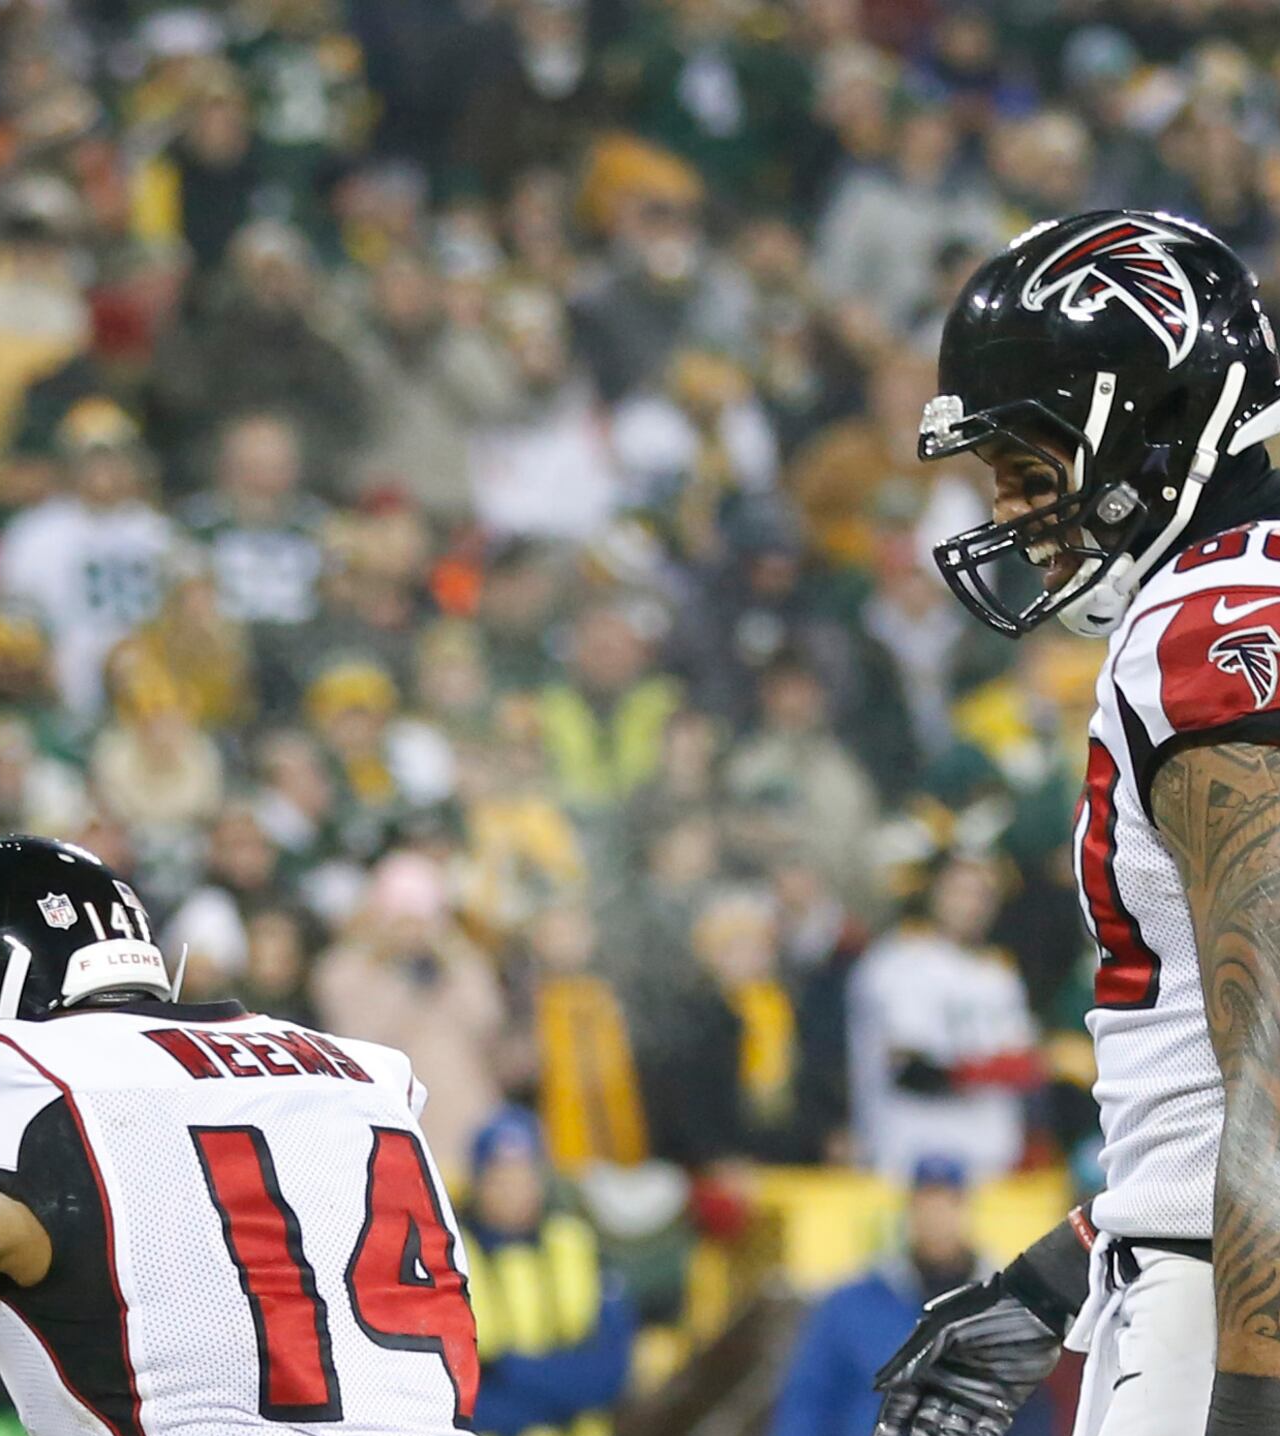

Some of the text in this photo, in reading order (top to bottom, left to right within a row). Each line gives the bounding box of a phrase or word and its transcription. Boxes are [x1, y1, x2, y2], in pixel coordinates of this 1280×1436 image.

[79, 953, 160, 971] FLCONS
[140, 1028, 375, 1083] WEEMS
[187, 1125, 481, 1429] 14
